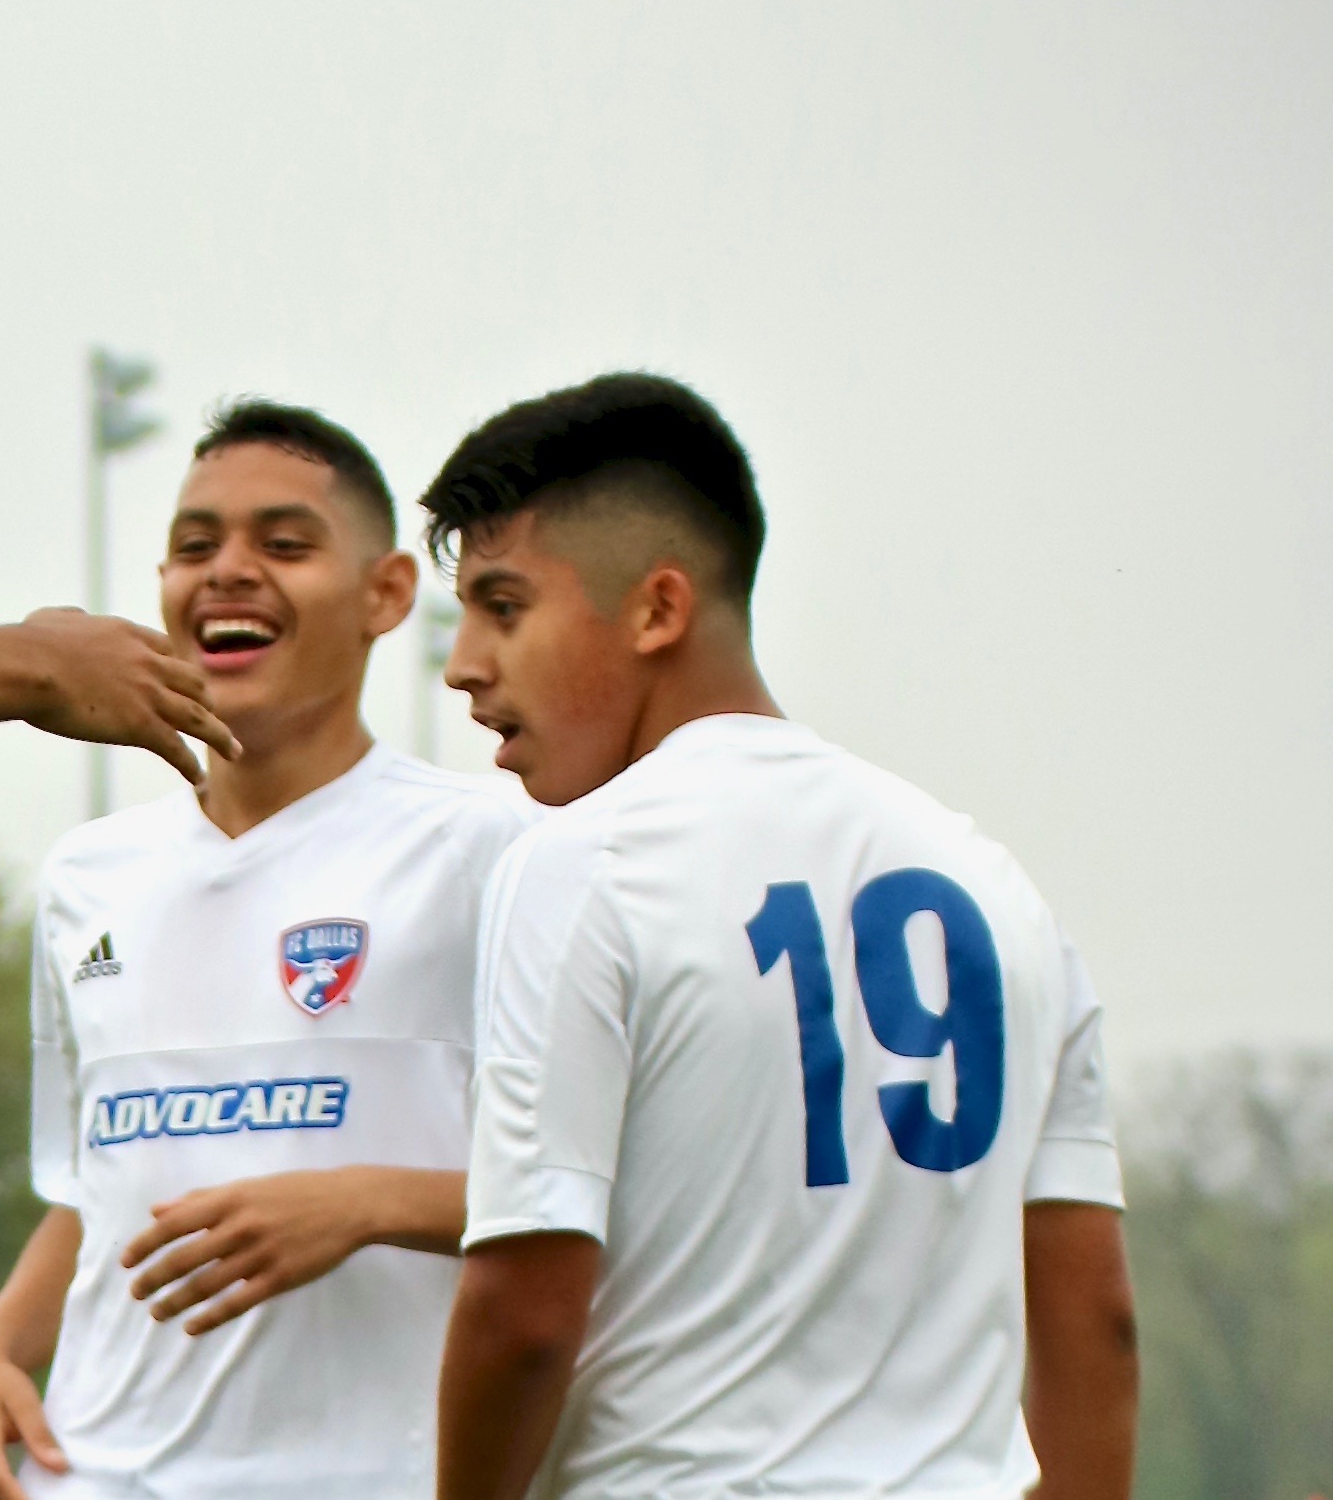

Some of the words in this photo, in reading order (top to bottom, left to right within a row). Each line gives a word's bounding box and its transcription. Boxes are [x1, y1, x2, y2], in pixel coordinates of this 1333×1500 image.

[307, 925, 359, 949] DALLAS
[744, 866, 1006, 1187] 19
[89, 1076, 349, 1147] ADVOCARE
